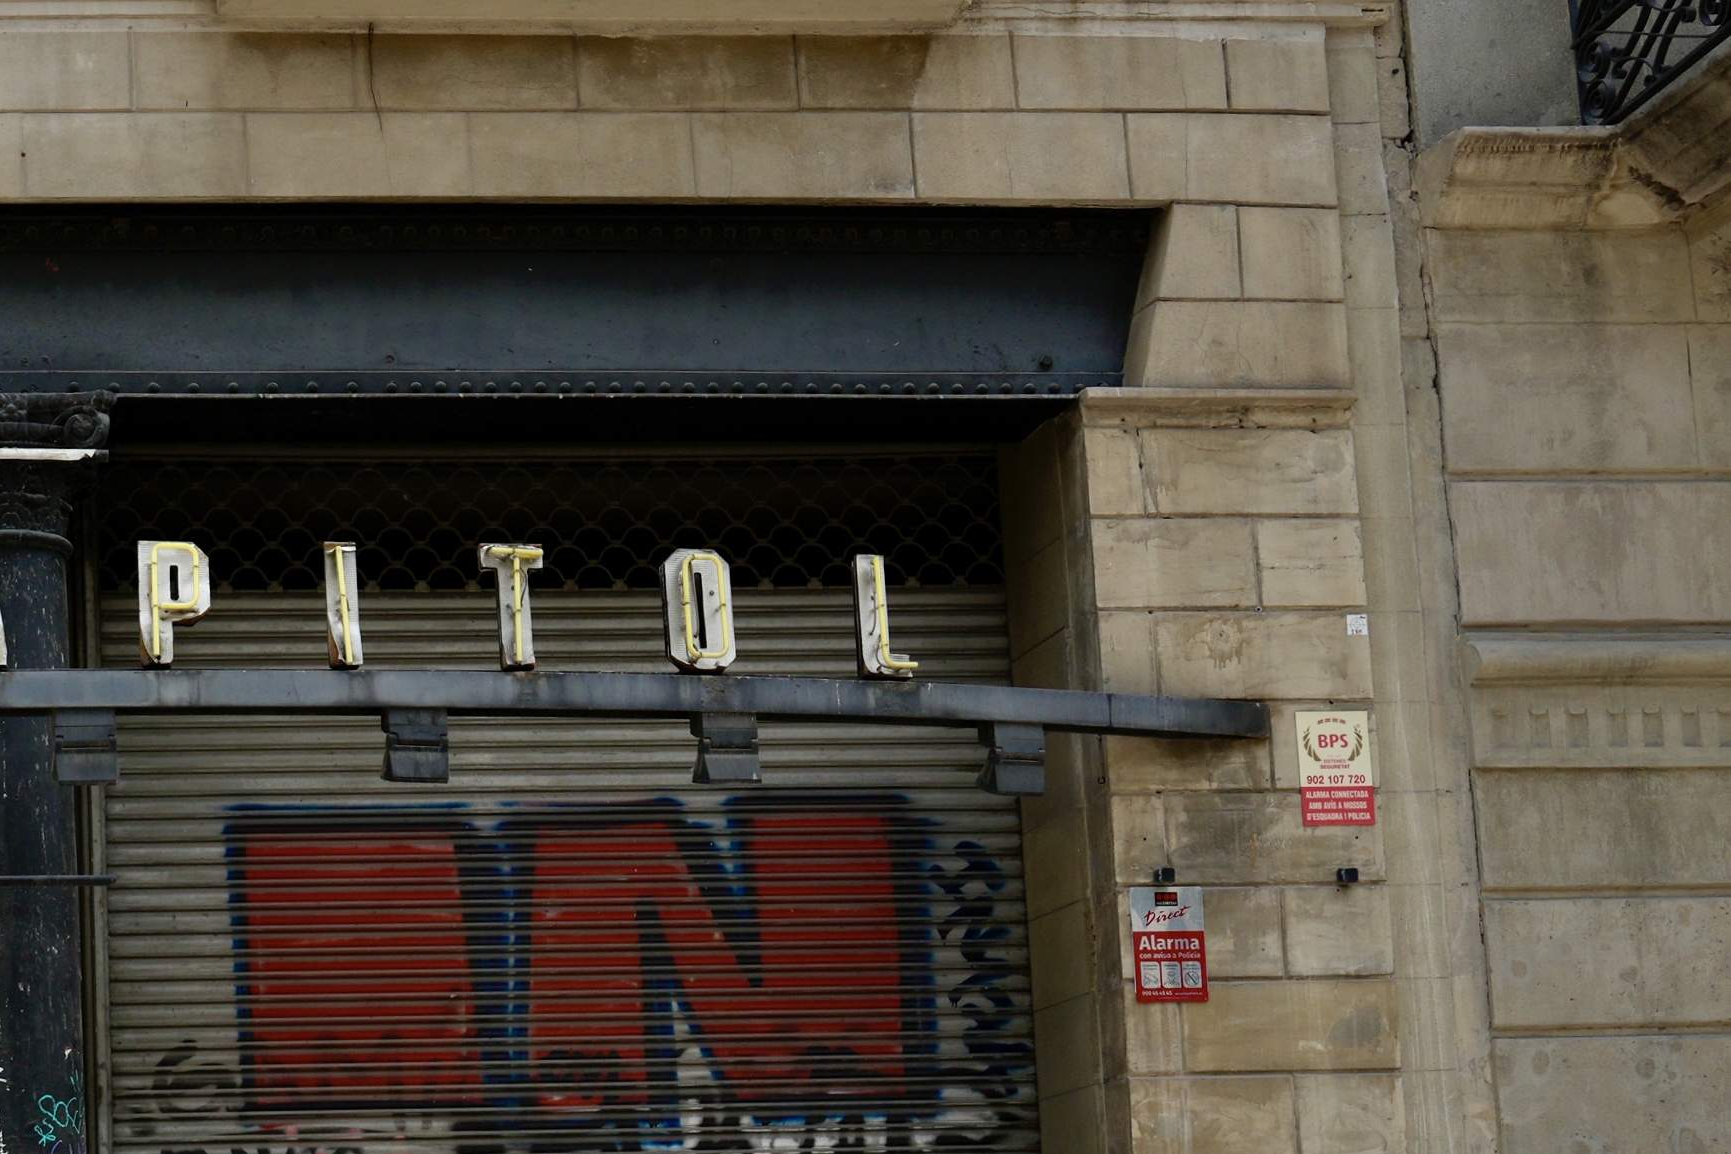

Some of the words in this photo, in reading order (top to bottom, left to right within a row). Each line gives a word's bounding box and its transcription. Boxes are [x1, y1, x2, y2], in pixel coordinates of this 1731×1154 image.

[1317, 734, 1349, 748] BPS
[1306, 775, 1325, 784] 902
[1328, 775, 1345, 784] 107
[1348, 774, 1366, 784] 720
[1306, 791, 1330, 799] ALARMA
[1331, 790, 1369, 798] CONNECTADA
[1343, 801, 1368, 809] MOSSOS
[1143, 905, 1191, 927] Direct
[1139, 935, 1200, 950] Alarma
